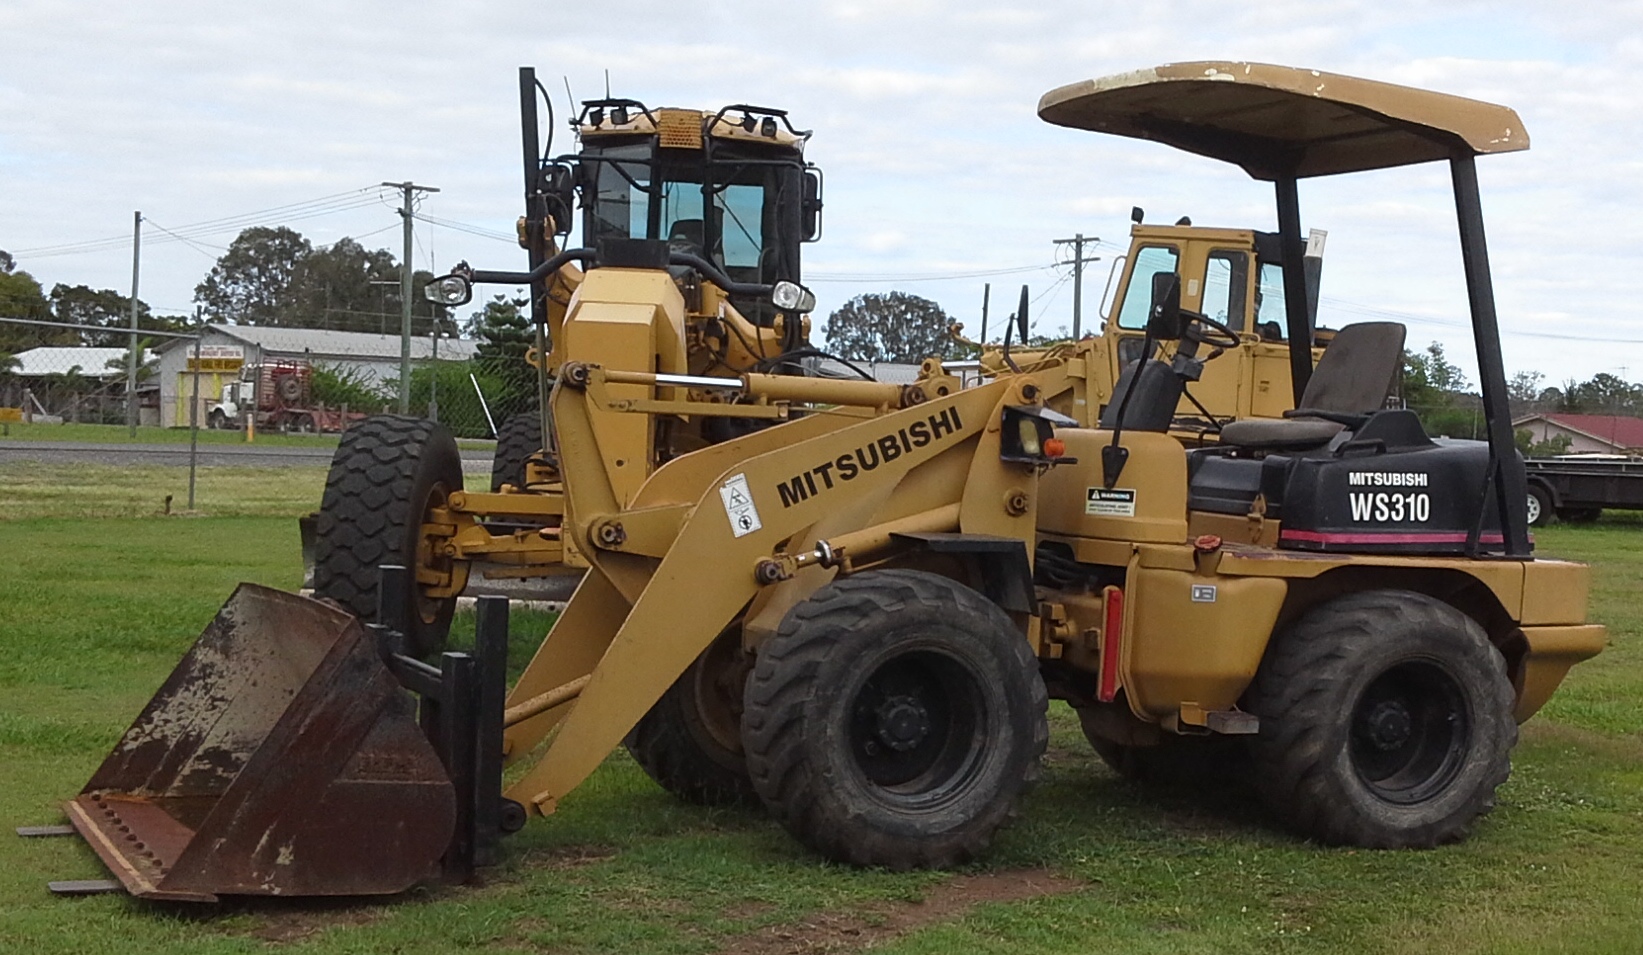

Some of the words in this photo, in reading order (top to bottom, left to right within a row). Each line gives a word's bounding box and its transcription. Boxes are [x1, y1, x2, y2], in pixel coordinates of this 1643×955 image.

[776, 406, 962, 508] MITSUBISHI
[1348, 472, 1428, 487] MITSUBISHI
[1349, 493, 1430, 522] WS310
